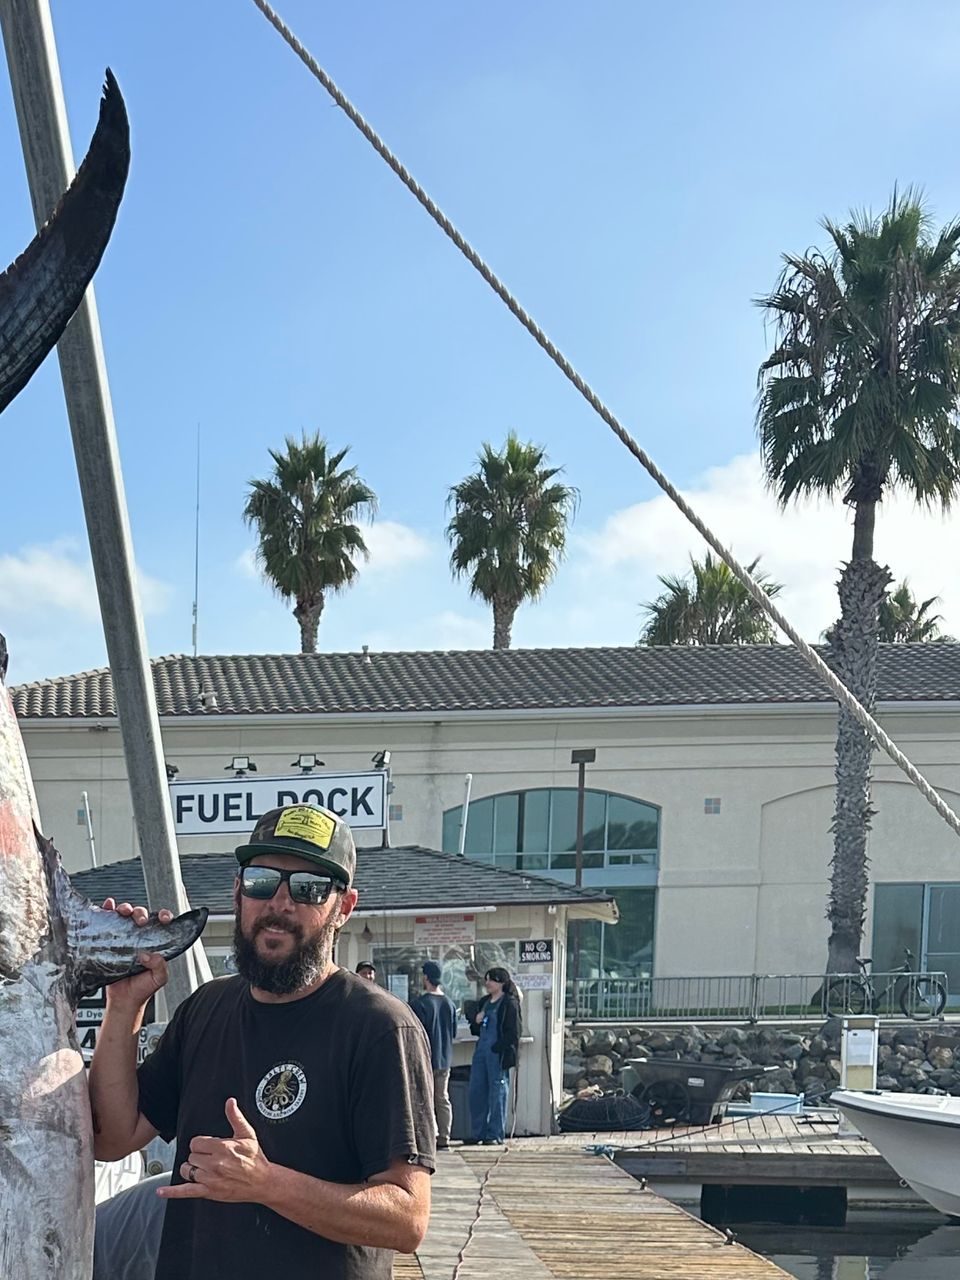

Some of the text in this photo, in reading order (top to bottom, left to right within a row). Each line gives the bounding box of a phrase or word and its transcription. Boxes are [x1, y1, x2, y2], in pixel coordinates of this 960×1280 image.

[176, 792, 263, 824] FUEL
[278, 786, 375, 817] DOCK
[525, 942, 535, 951] NO
[521, 951, 551, 962] SMOKING
